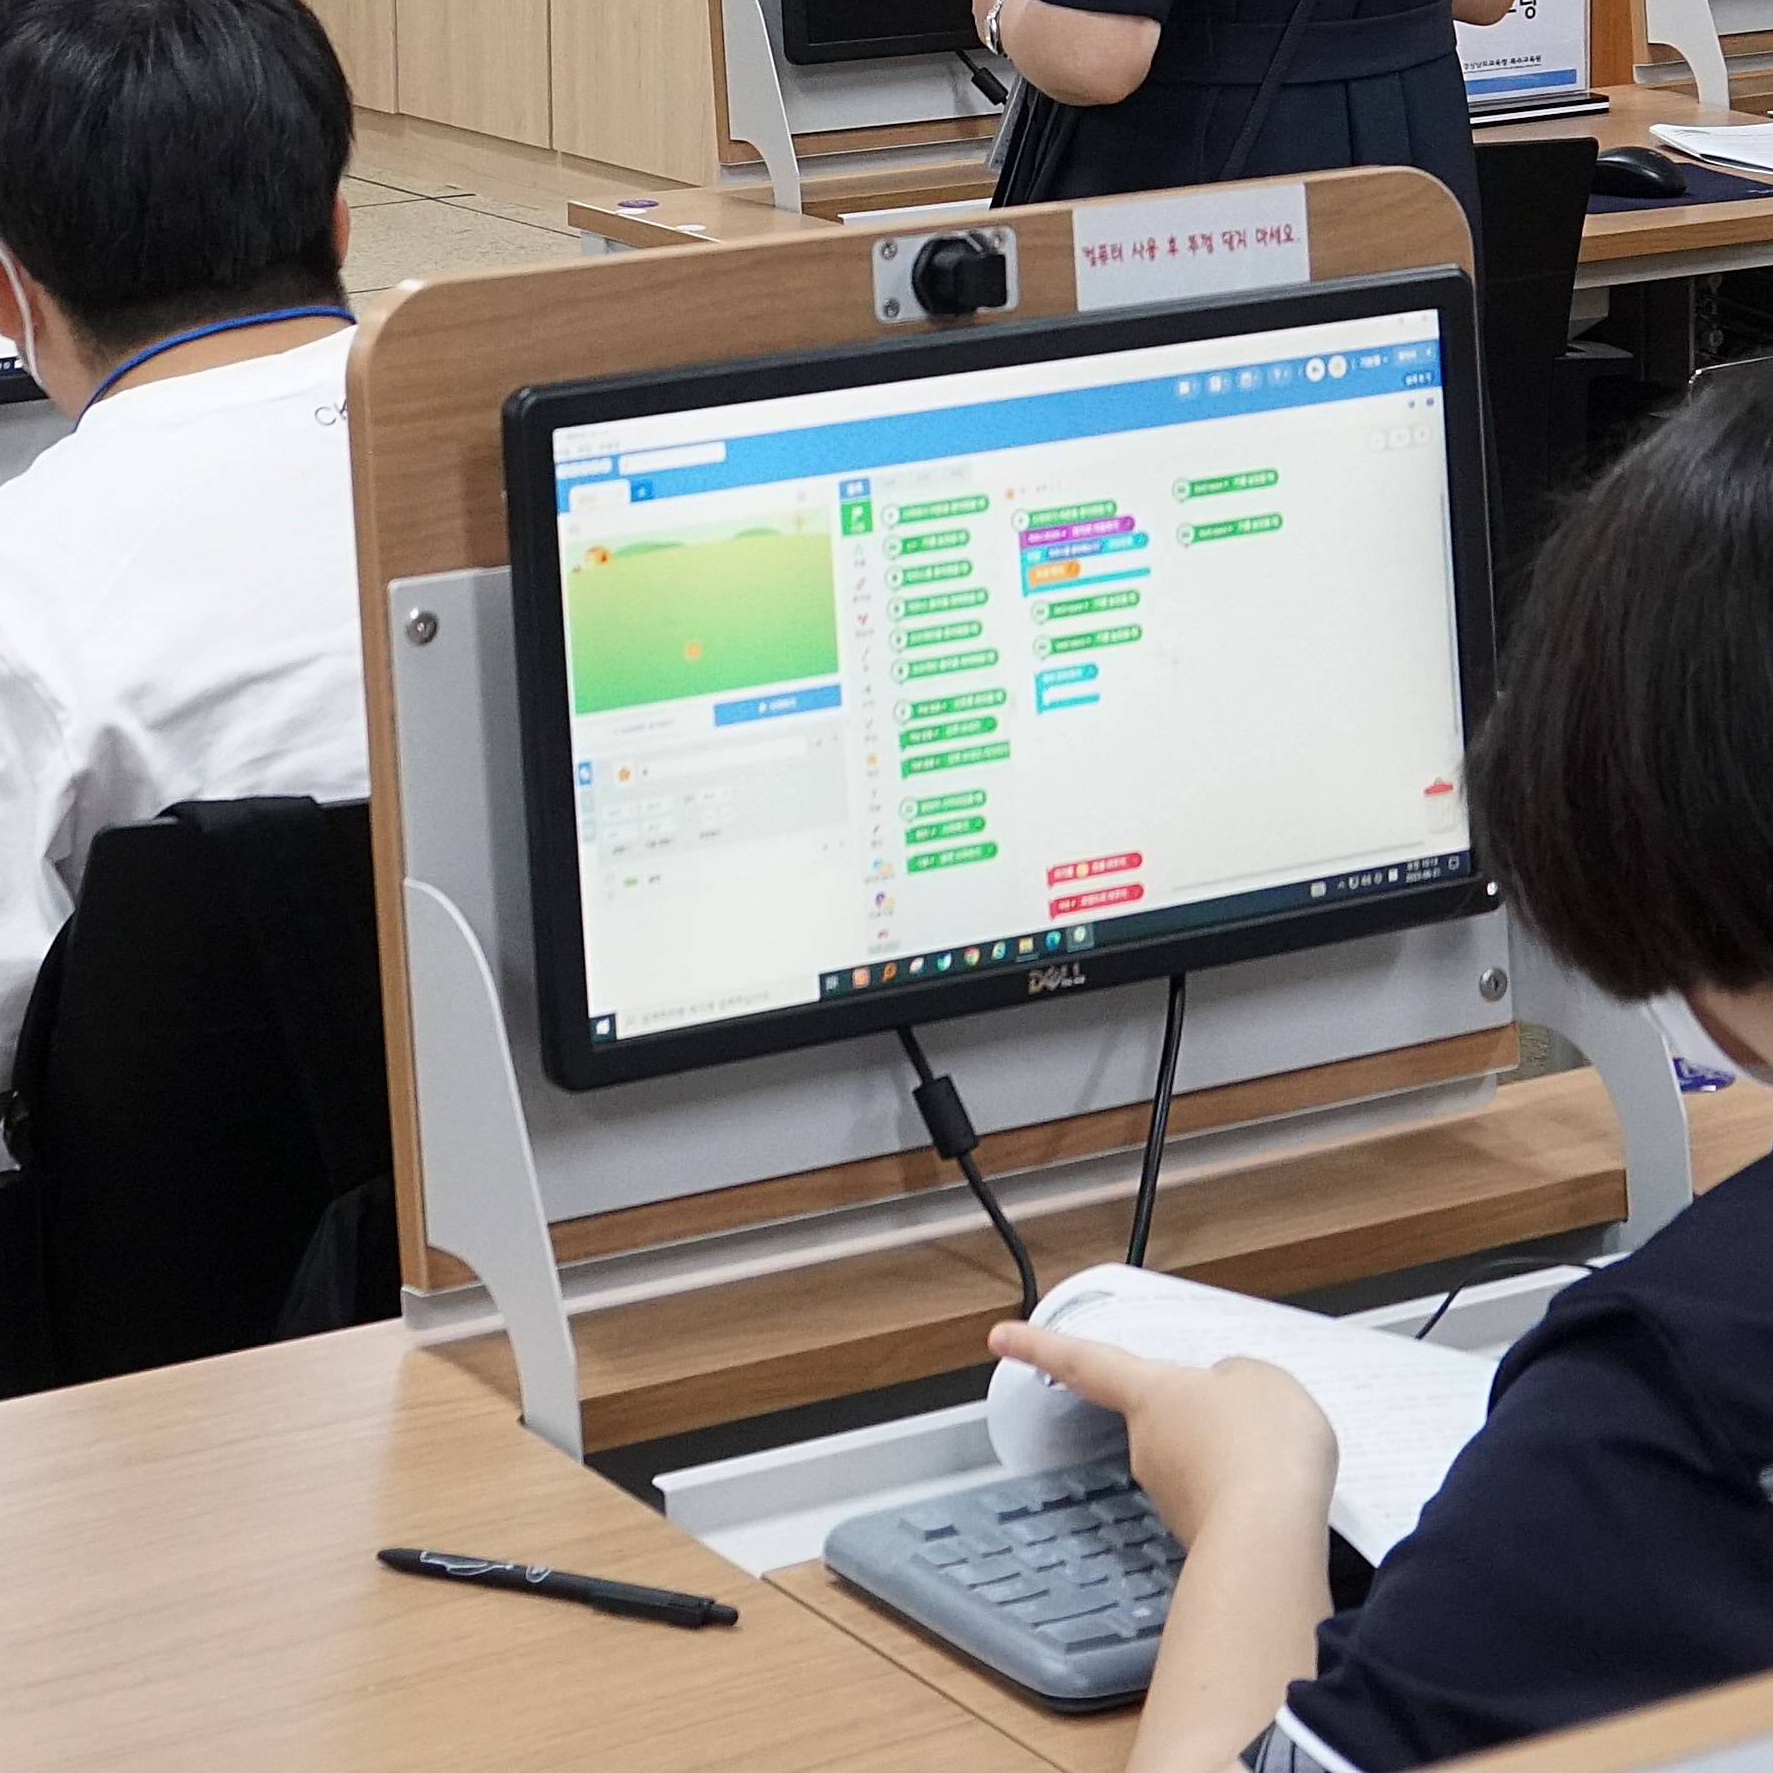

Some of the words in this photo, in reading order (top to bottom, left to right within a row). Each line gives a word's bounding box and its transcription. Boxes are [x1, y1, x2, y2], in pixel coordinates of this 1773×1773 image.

[1131, 237, 1157, 261] 사용
[1167, 233, 1179, 256] 후
[1027, 963, 1086, 995] DELL
